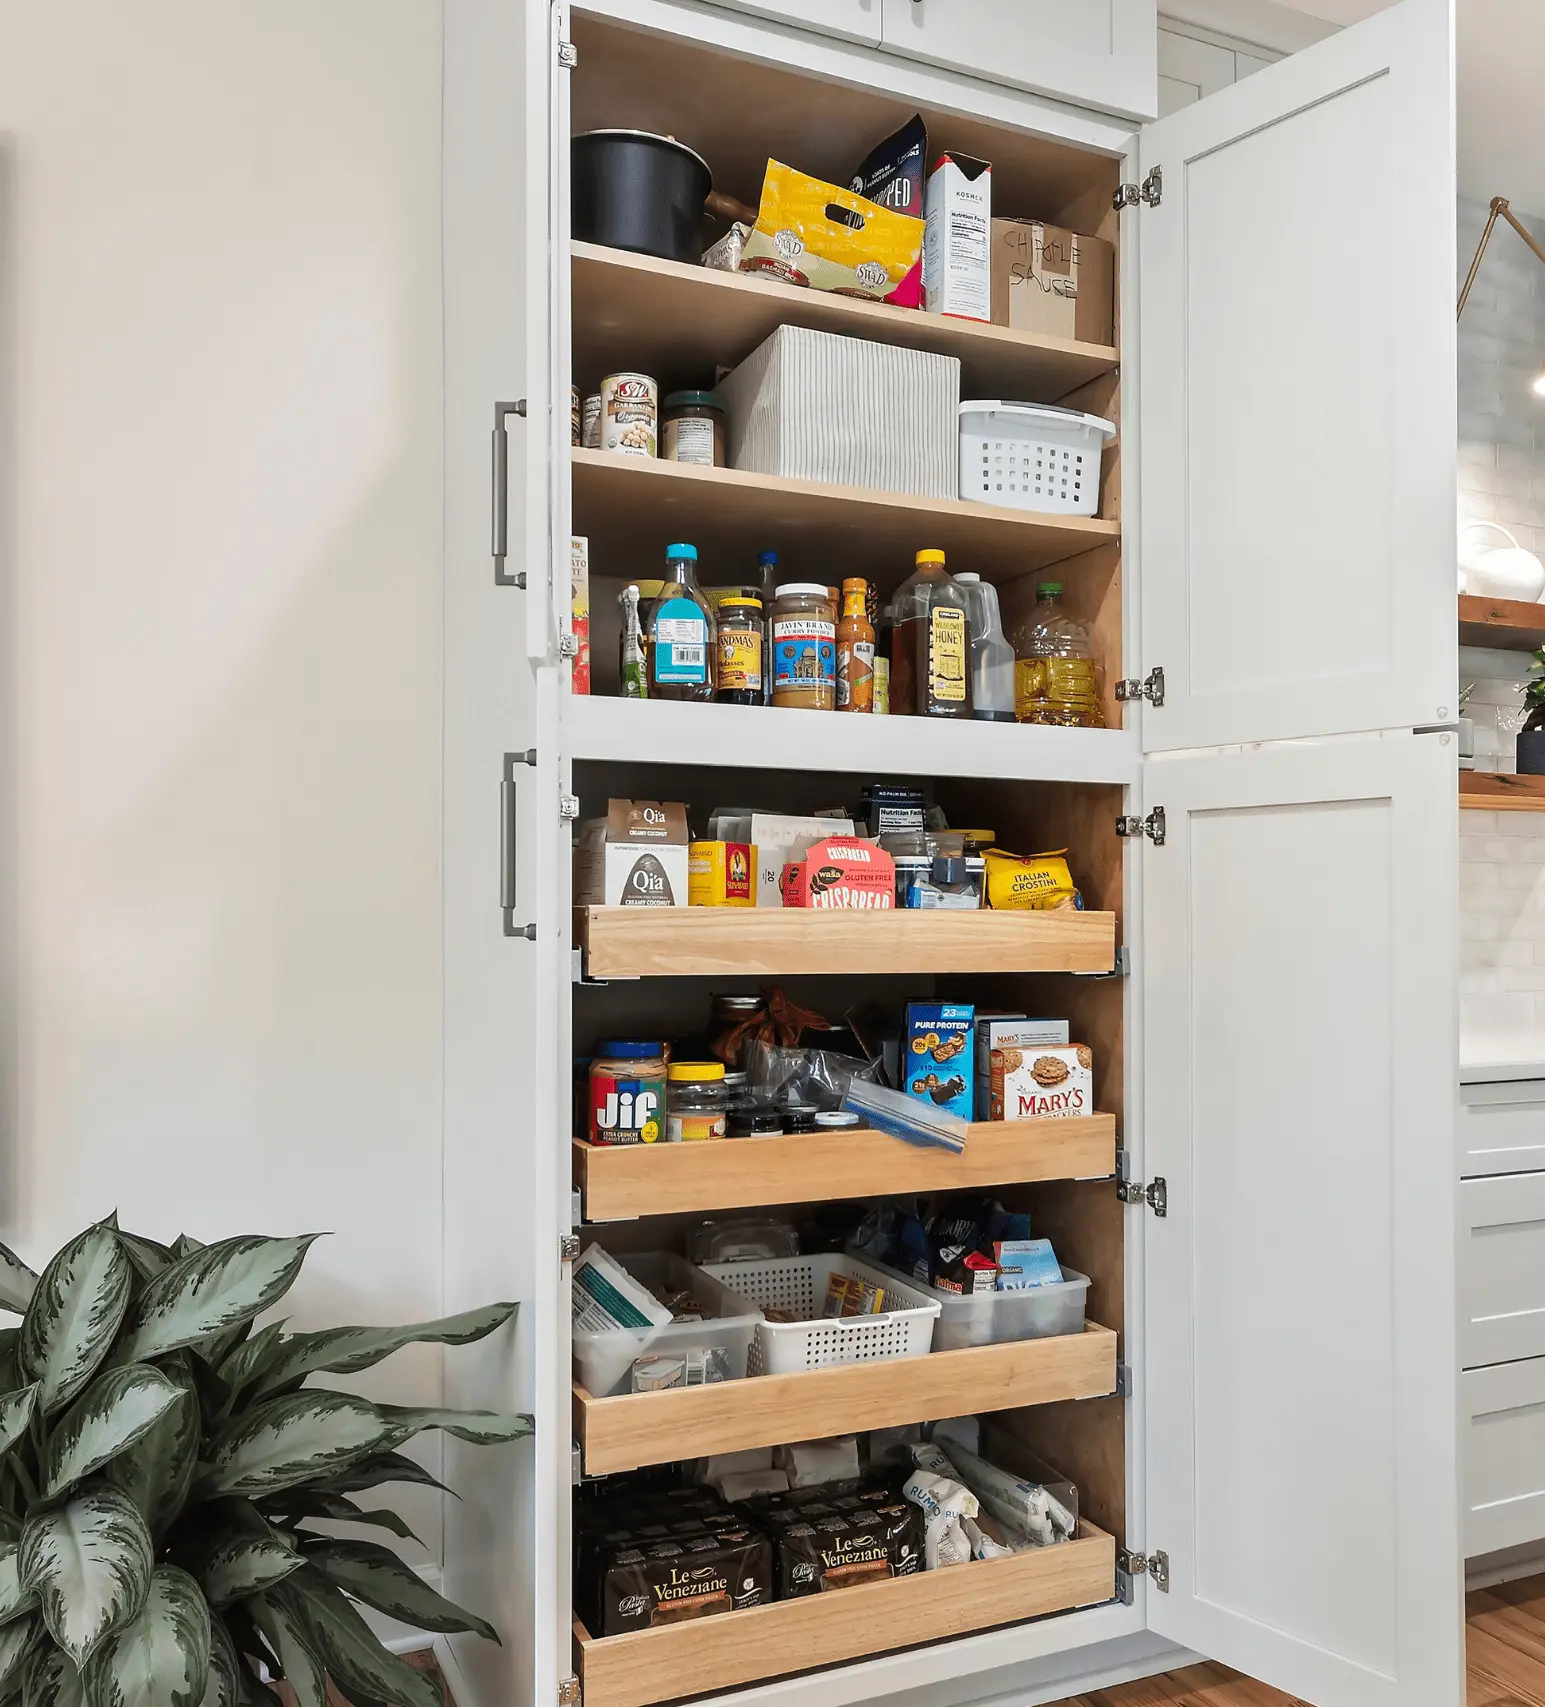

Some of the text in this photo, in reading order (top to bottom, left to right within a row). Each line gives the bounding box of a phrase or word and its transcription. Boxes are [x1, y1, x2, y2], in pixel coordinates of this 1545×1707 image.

[956, 191, 983, 203] KOSHER
[951, 212, 974, 220] Nutrition
[774, 234, 802, 255] SWAD
[857, 266, 886, 285] SWAD
[1010, 262, 1078, 299] SAUCE
[617, 411, 650, 424] Organic
[935, 631, 963, 645] HONEY
[827, 847, 871, 862] CRISPBREAD
[767, 871, 775, 882] 20
[1014, 871, 1050, 882] ITALIAN
[1012, 879, 1057, 892] CROSTINI
[942, 1008, 957, 1017] 23
[915, 1021, 969, 1030] PURE PROTEIN
[997, 1033, 1020, 1044] MARY'S
[1018, 1087, 1084, 1116] MARY'S
[596, 1091, 657, 1128] Jif
[835, 1537, 852, 1552] Le
[821, 1547, 888, 1568] Veneziane
[670, 1568, 690, 1585] Le
[653, 1578, 728, 1600] Veneziane
